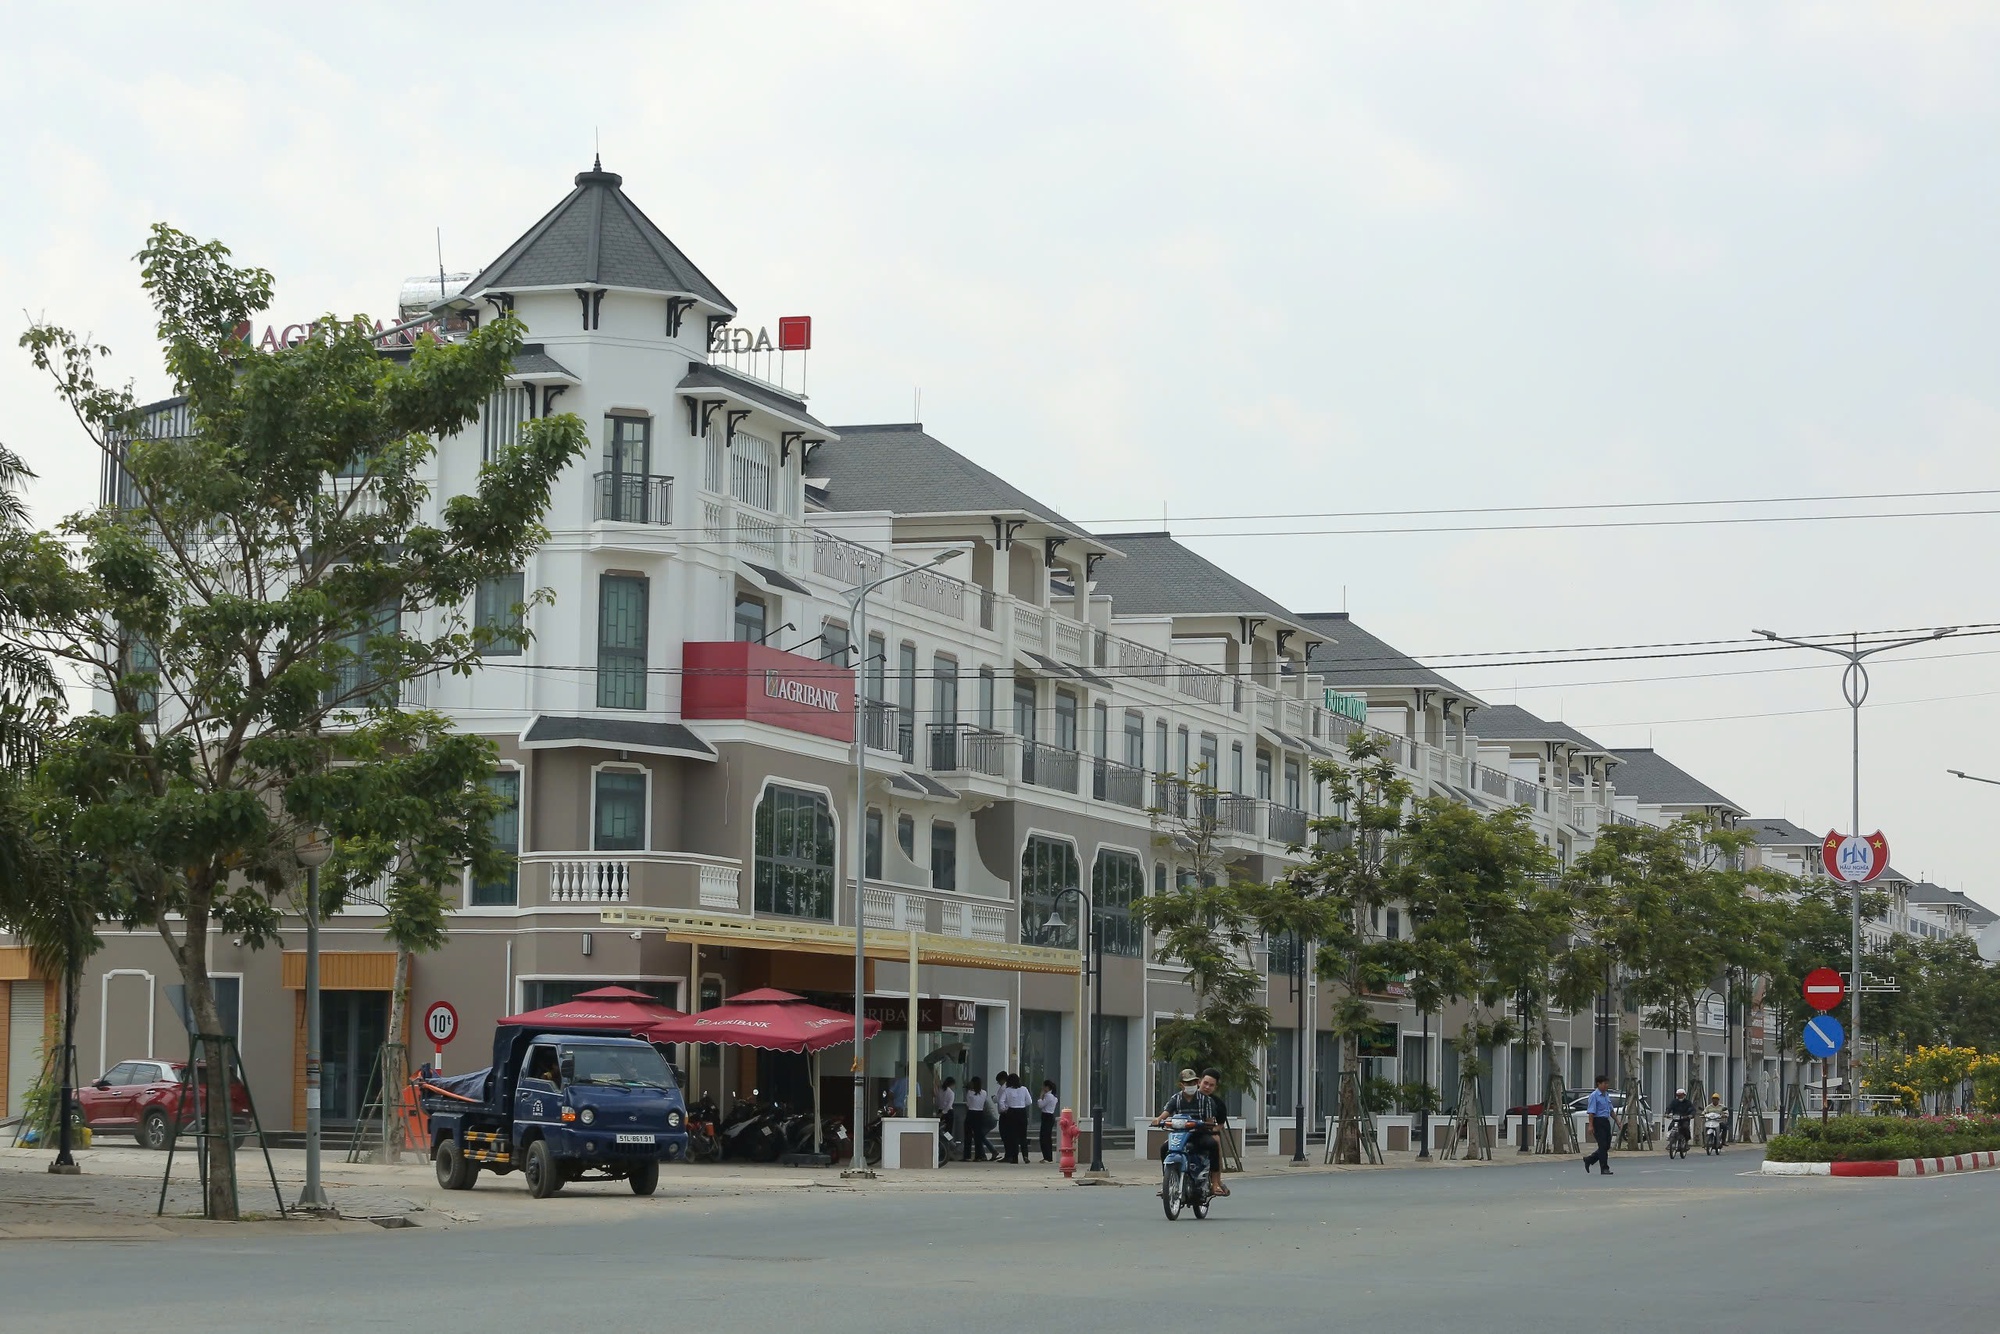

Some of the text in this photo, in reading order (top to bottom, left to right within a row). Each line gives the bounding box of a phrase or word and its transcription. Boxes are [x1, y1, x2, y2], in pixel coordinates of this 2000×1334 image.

[779, 679, 840, 712] AGRIBANK
[958, 1002, 976, 1021] CDM
[710, 1019, 771, 1028] AGRIBANK
